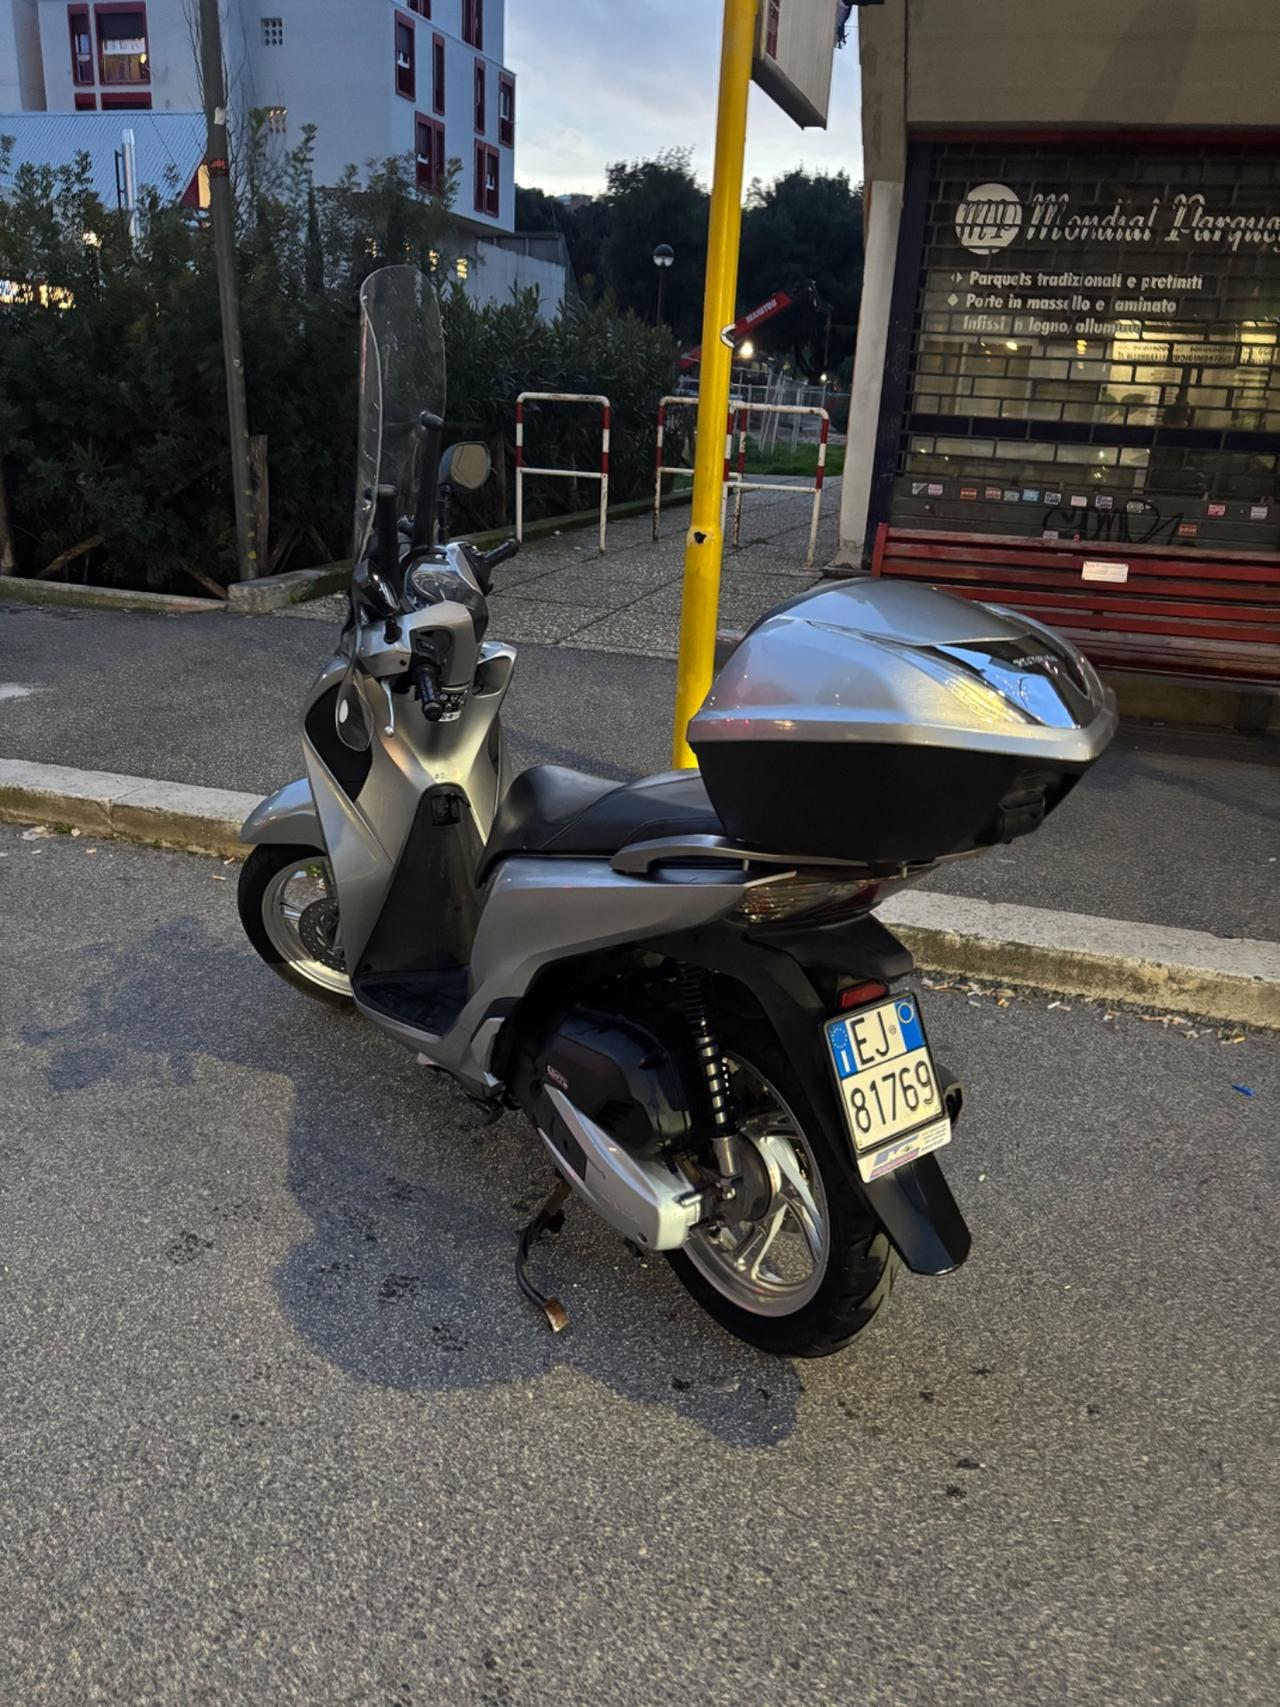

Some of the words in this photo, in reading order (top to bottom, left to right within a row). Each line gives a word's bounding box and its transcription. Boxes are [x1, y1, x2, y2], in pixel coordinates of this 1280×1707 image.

[1026, 193, 1160, 241] Mondial
[969, 271, 1032, 289] Parquets
[1127, 276, 1137, 289] e
[966, 293, 1003, 309] Porte
[1008, 293, 1021, 309] in
[1095, 299, 1105, 311] e
[1111, 296, 1177, 313] aminato
[963, 315, 1006, 331] Infissi
[850, 1010, 889, 1067] EJ
[850, 1060, 935, 1134] 81769
